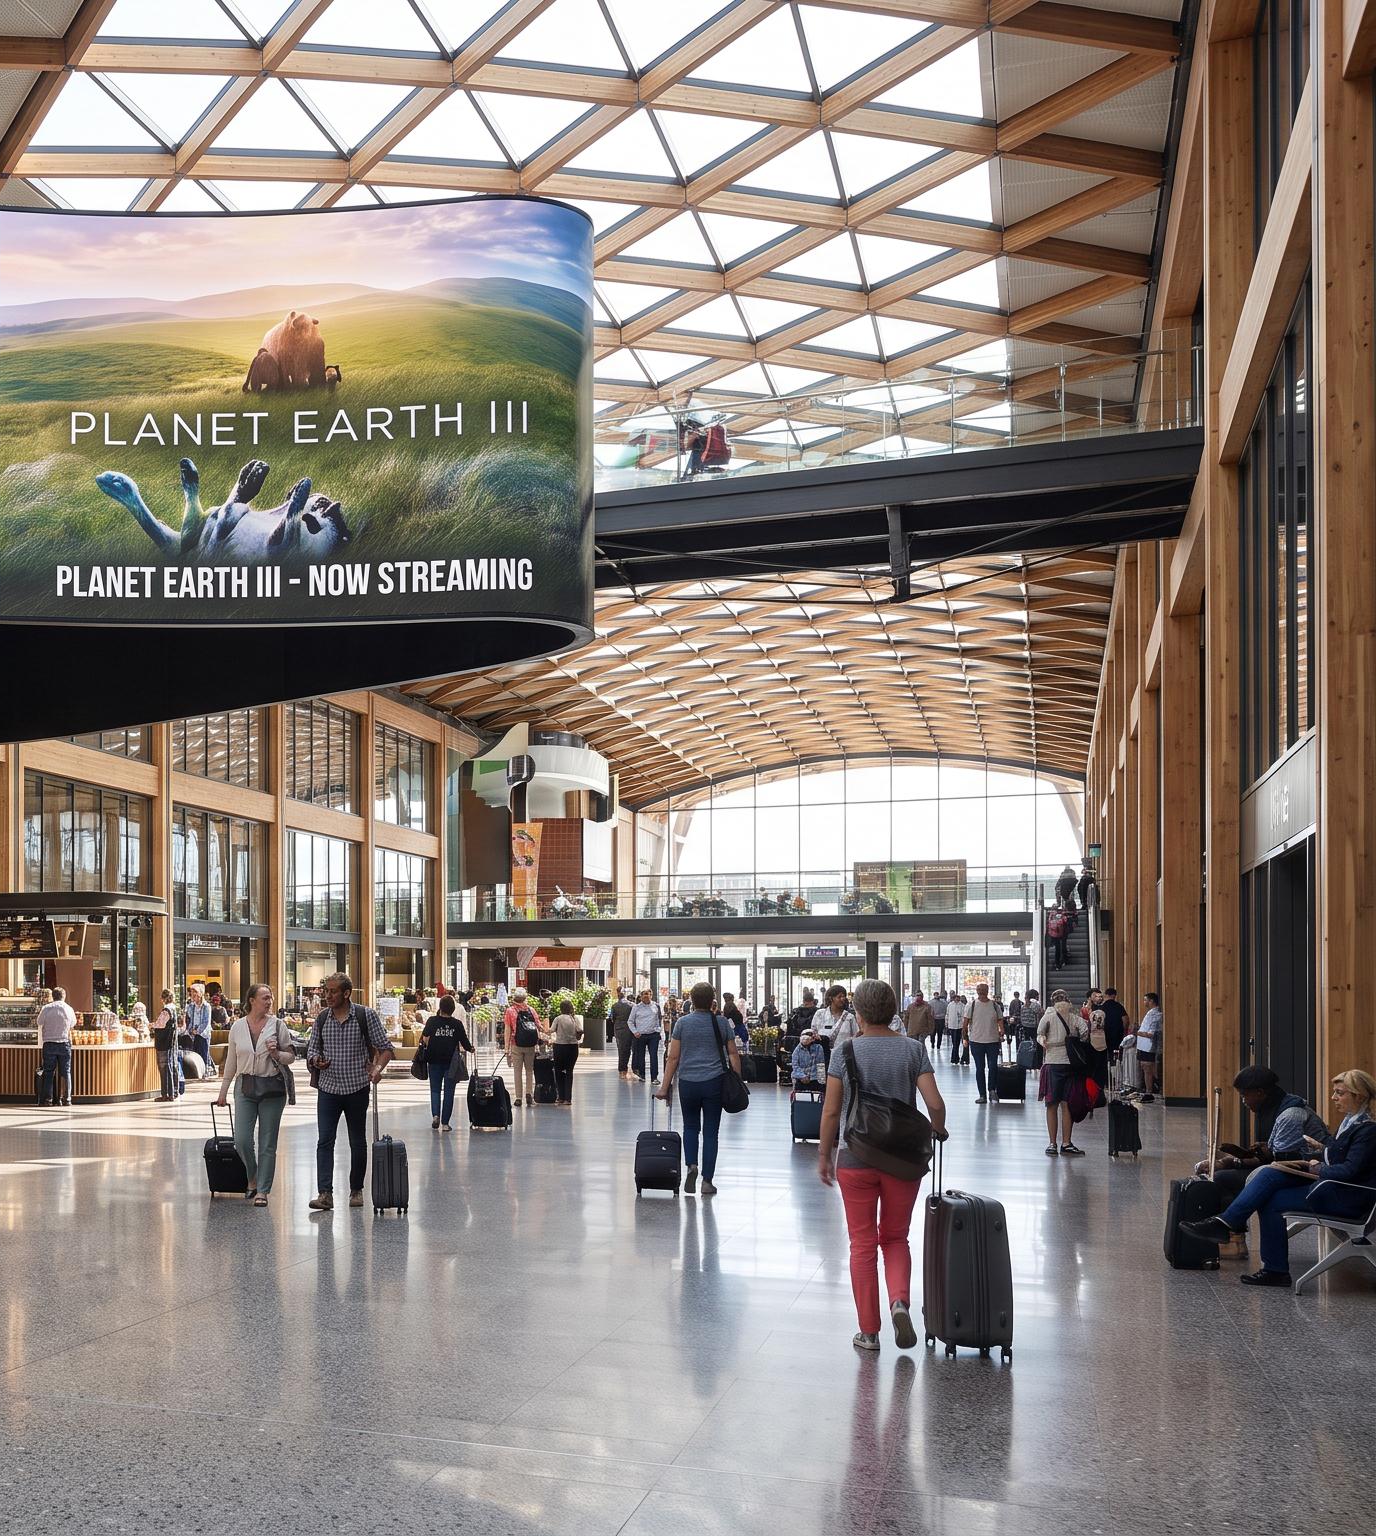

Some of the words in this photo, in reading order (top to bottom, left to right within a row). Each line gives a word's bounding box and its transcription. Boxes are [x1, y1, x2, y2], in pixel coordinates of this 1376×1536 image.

[70, 411, 269, 446] PLANET
[293, 402, 463, 444] EARTH
[489, 400, 528, 434] III
[56, 565, 156, 598] PLANET
[163, 566, 248, 598] EARTH
[256, 565, 281, 598] III
[309, 563, 371, 597] NOW
[378, 558, 533, 595] STREAMING
